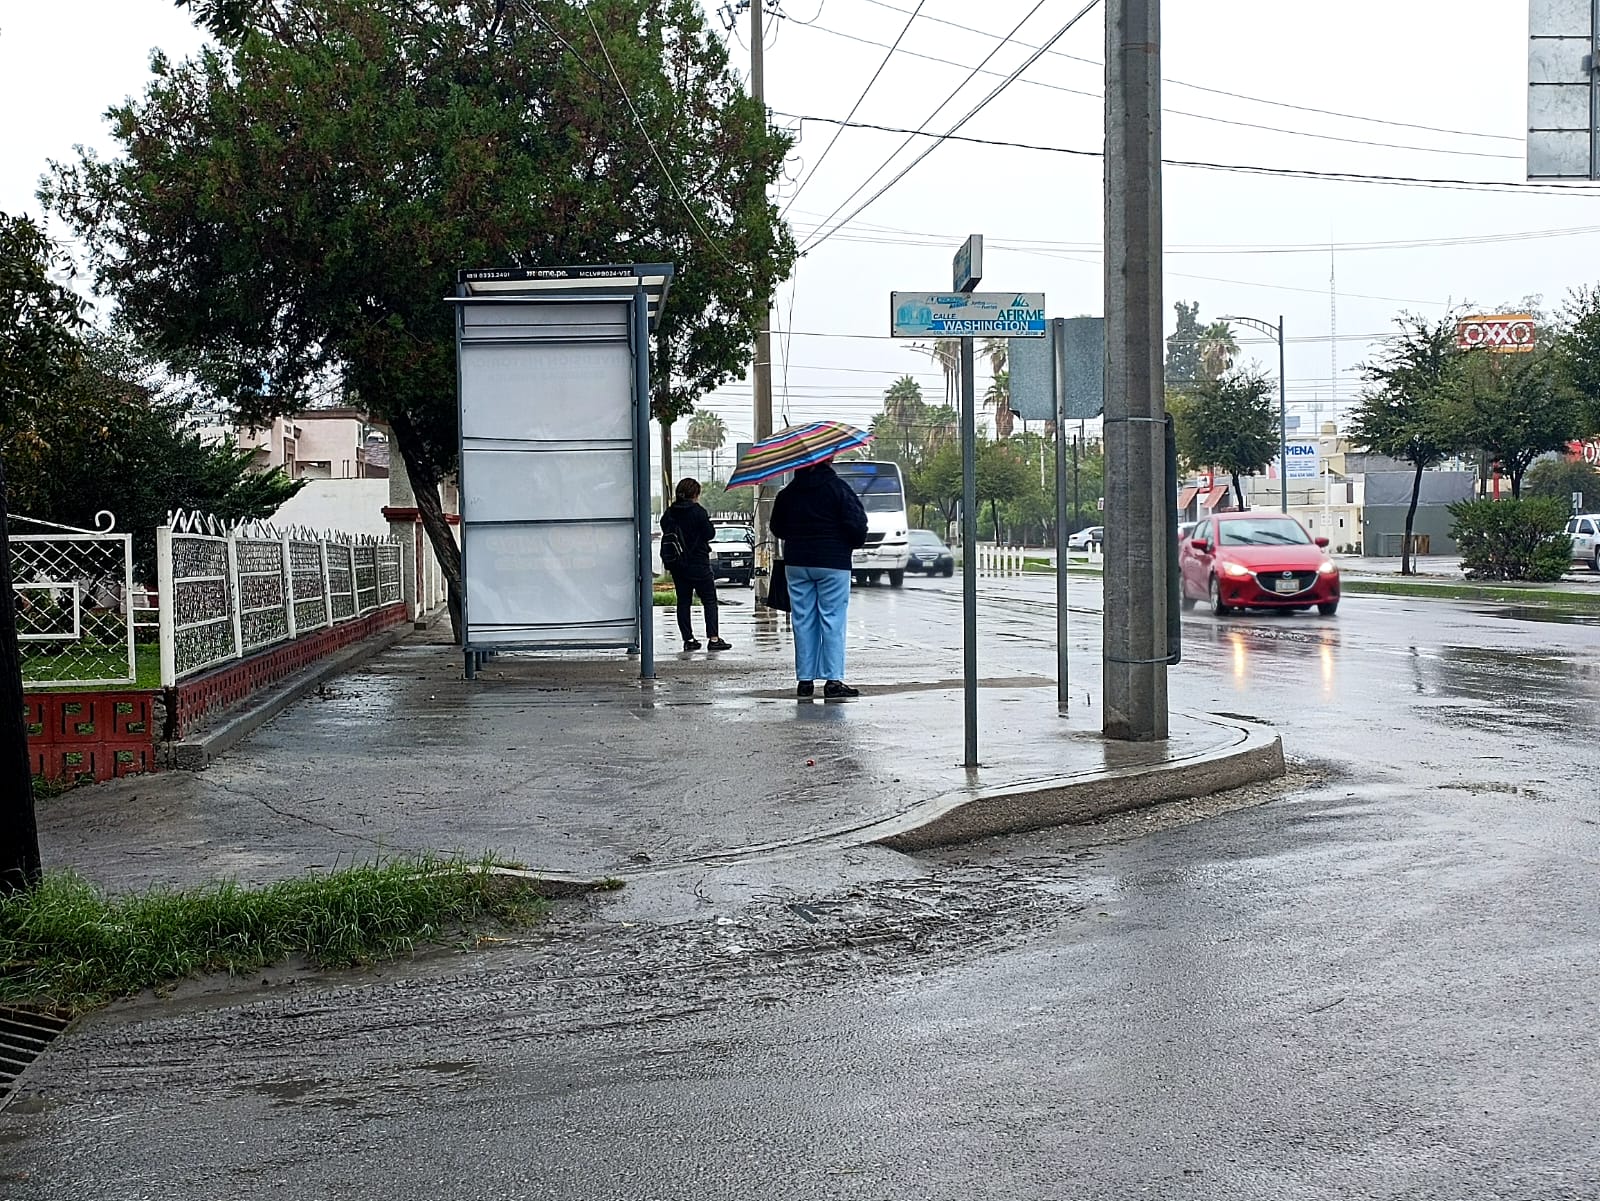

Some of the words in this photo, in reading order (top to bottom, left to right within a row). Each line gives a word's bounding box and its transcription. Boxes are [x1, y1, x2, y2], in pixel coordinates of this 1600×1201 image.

[997, 309, 1044, 321] AFIRME
[943, 320, 1029, 331] WASHINGTON
[1464, 323, 1531, 344] OXXO
